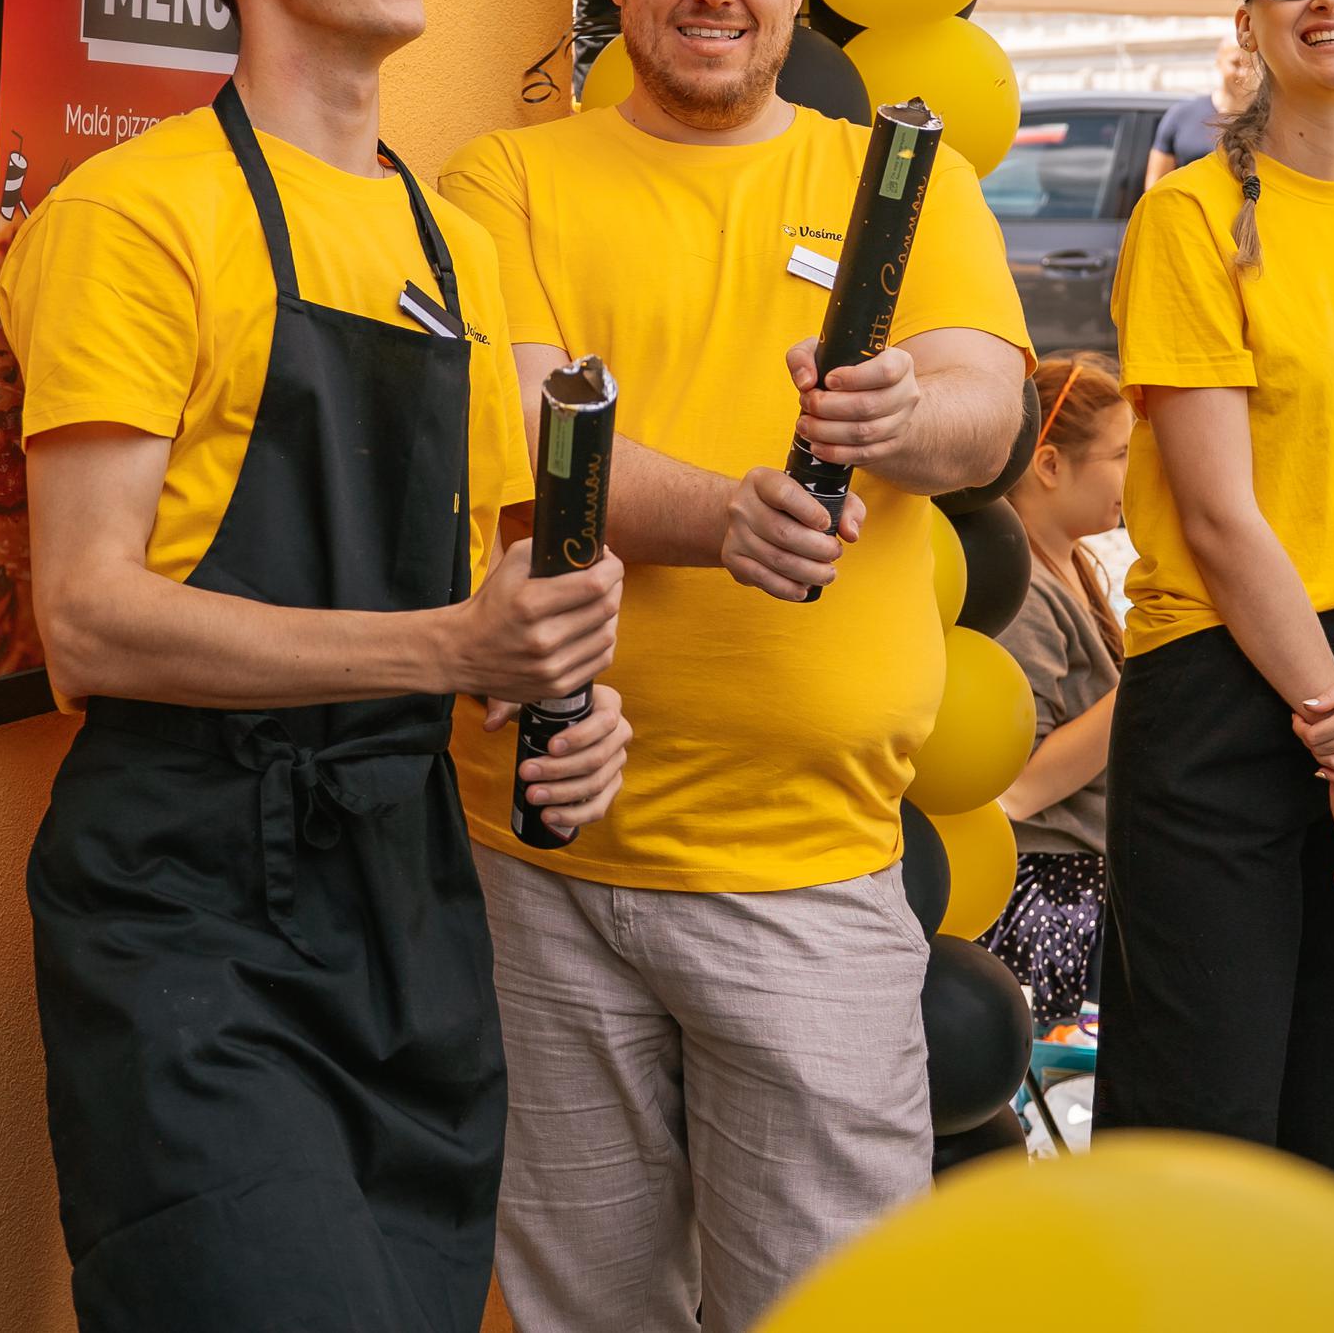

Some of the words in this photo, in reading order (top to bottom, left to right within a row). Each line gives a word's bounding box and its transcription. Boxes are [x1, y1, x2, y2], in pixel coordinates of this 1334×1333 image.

[65, 103, 111, 137] Malá
[880, 175, 927, 297] Cannon
[563, 454, 602, 568] Cannon
